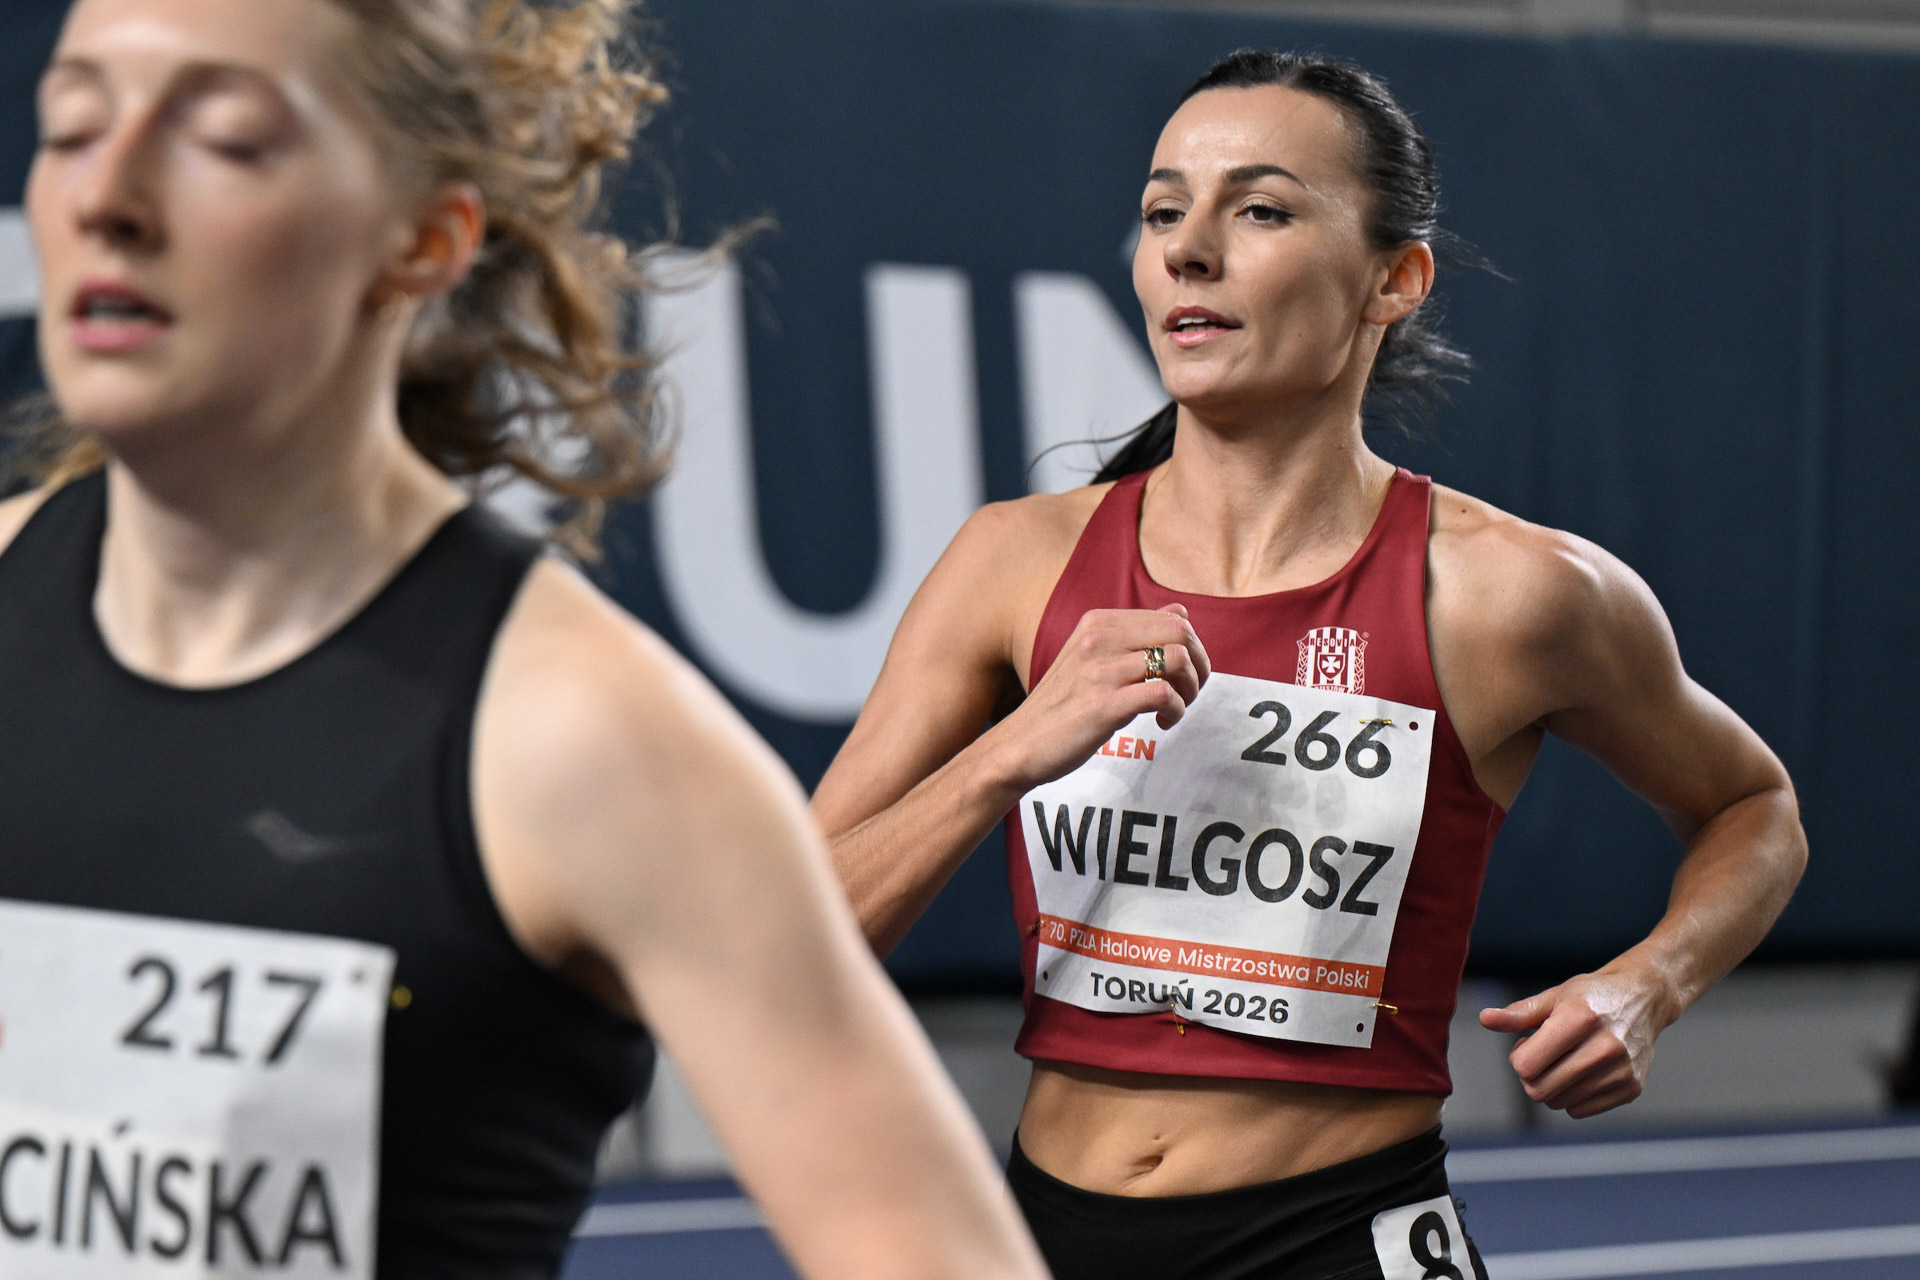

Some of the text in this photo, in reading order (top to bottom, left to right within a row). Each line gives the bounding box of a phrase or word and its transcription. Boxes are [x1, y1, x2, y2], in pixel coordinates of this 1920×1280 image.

[1310, 637, 1356, 648] RESOVIA
[1095, 736, 1157, 761] LEN
[1240, 700, 1392, 779] 266
[1033, 800, 1395, 917] WIELGOSZ
[1050, 921, 1370, 989] 70. PZLA Halowe Mistrzostwa Polski
[117, 952, 325, 1070] 217
[1090, 972, 1290, 1024] TORUŃ 2026
[1408, 1210, 1465, 1280] 8
